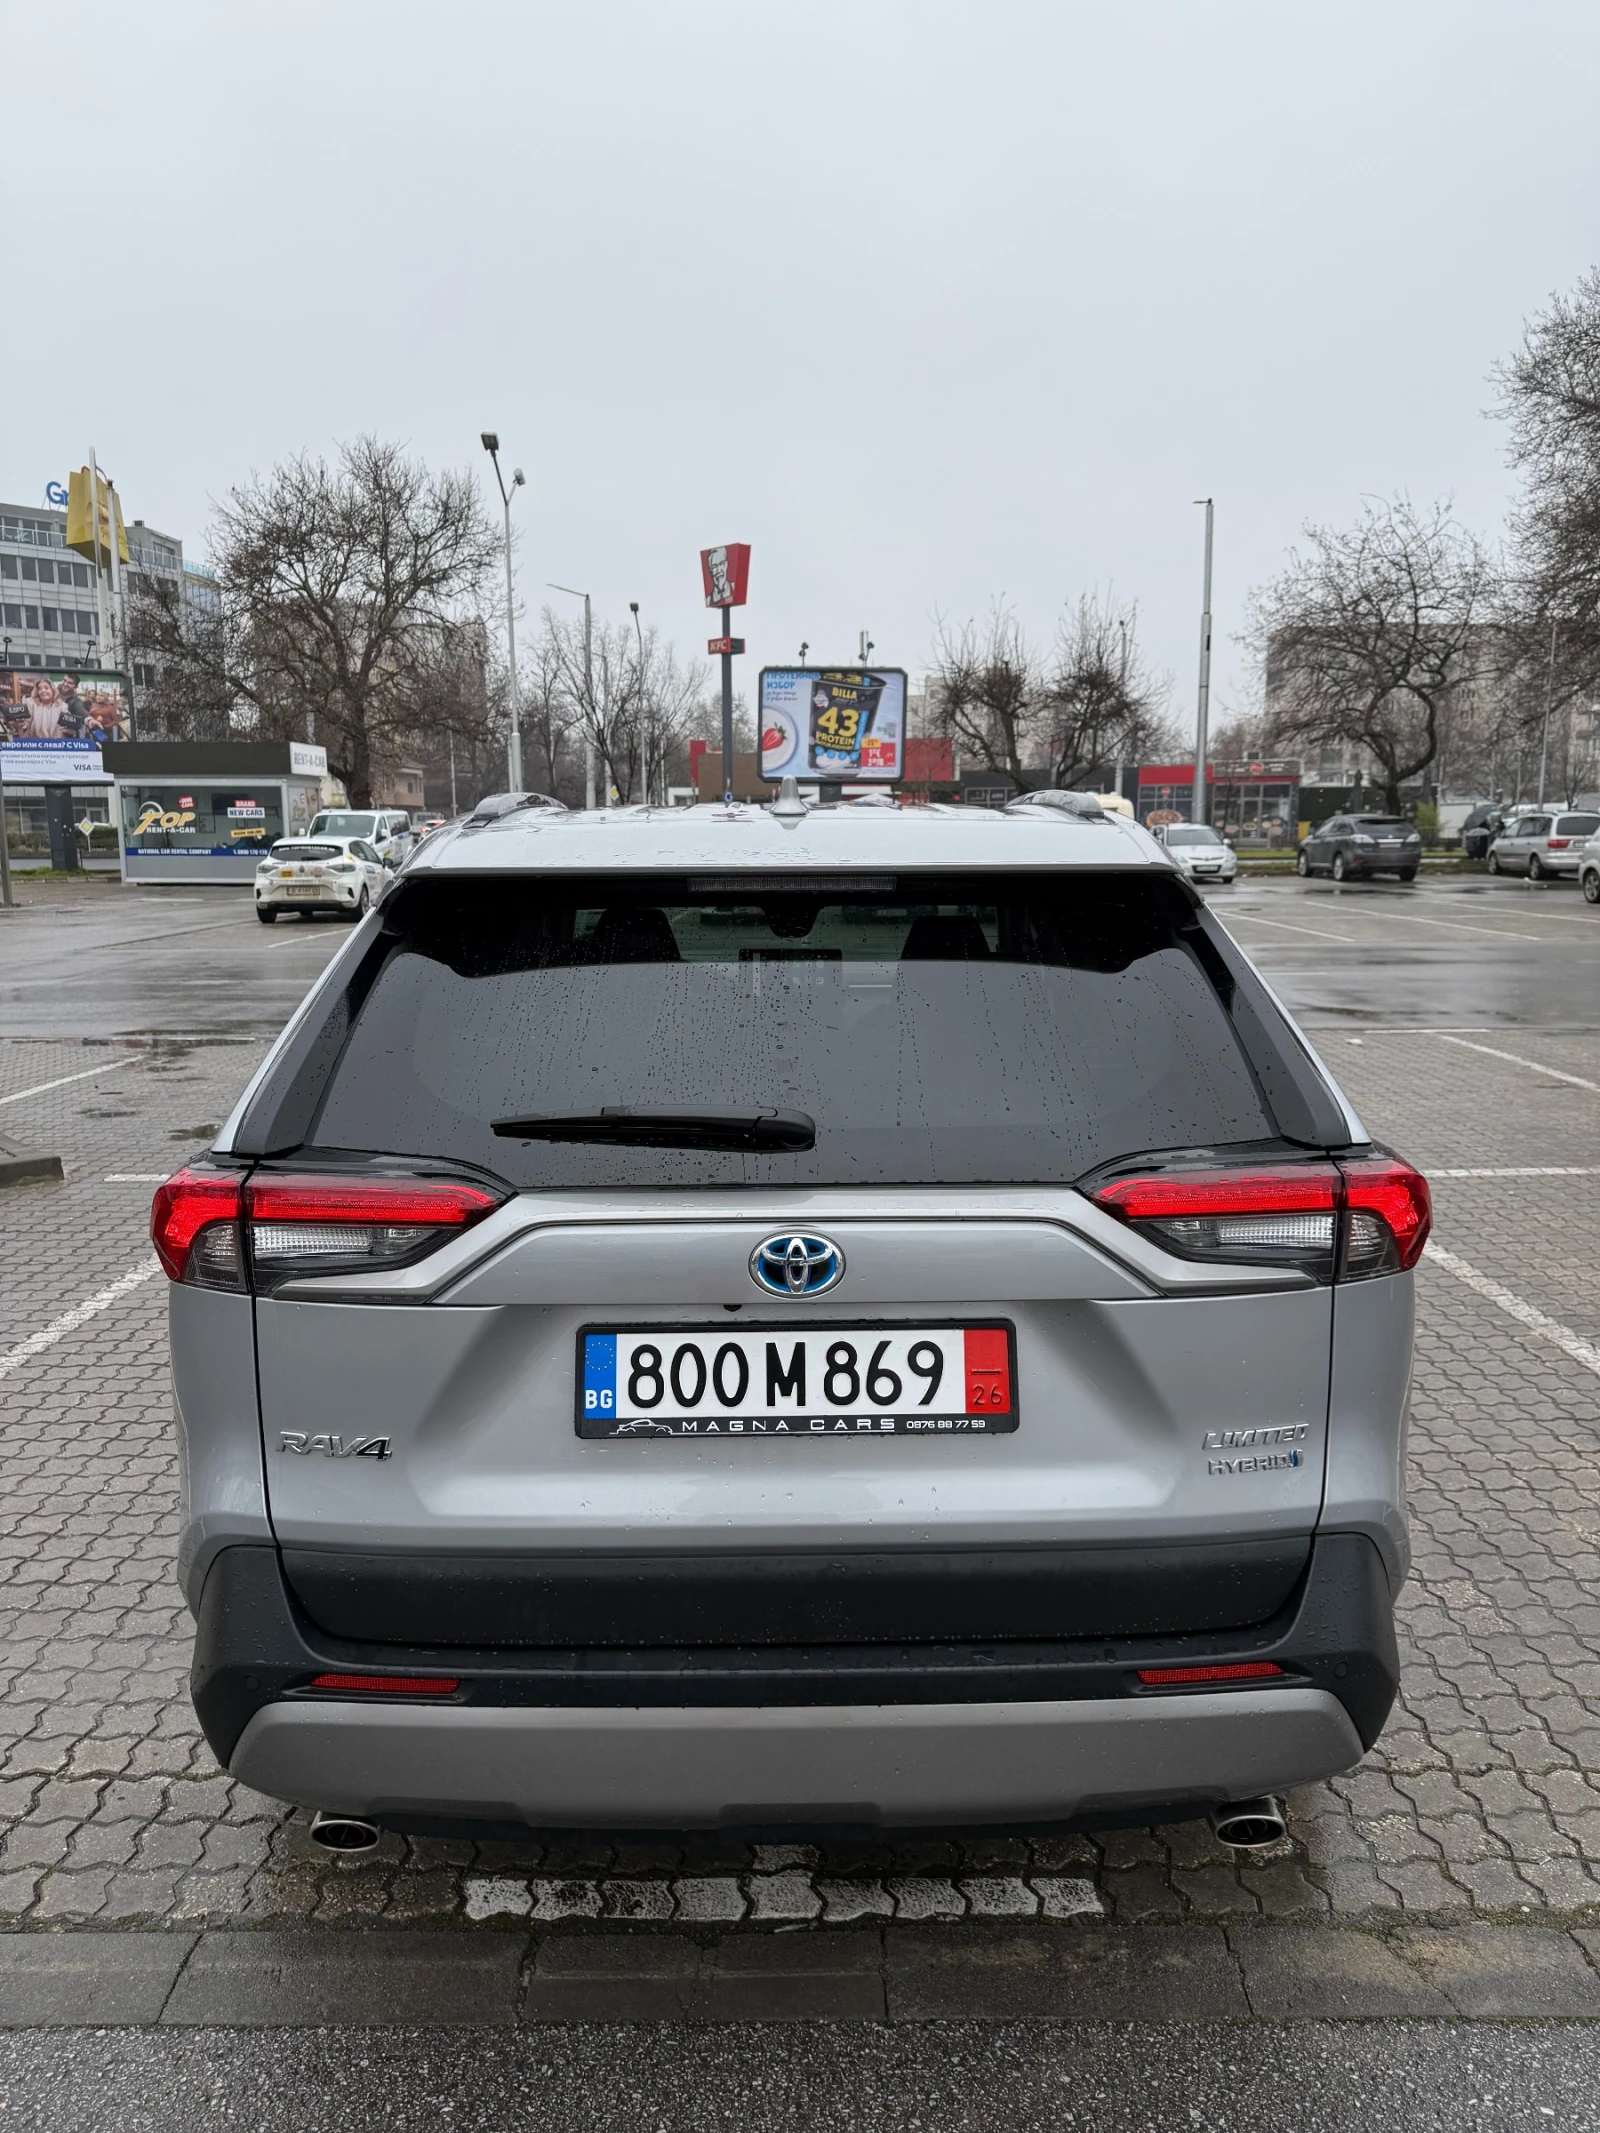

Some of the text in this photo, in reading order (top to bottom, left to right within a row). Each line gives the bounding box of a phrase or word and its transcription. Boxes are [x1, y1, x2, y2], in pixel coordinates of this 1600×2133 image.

[710, 641, 727, 652] KFC
[766, 681, 795, 689] ИЗБОР
[832, 687, 857, 699] BILLA
[8, 706, 25, 714] ЕВРО
[62, 714, 77, 723] ЛЕВА
[818, 706, 859, 737] 43
[815, 731, 855, 745] PROTEIN
[294, 752, 326, 768] RENT-A-CAR
[133, 811, 196, 836] TOP
[146, 826, 196, 834] RENT-A-CAR
[628, 1340, 944, 1408] 800 M 869
[585, 1389, 613, 1410] BG
[973, 1384, 1002, 1406] 26
[682, 1418, 895, 1431] MAGNA CARS
[906, 1420, 935, 1429] 0876
[955, 1420, 969, 1429] 77
[971, 1419, 986, 1428] 59
[1202, 1421, 1309, 1450] LIMITED
[275, 1431, 392, 1460] RAV4
[1208, 1454, 1288, 1475] HYBRID
